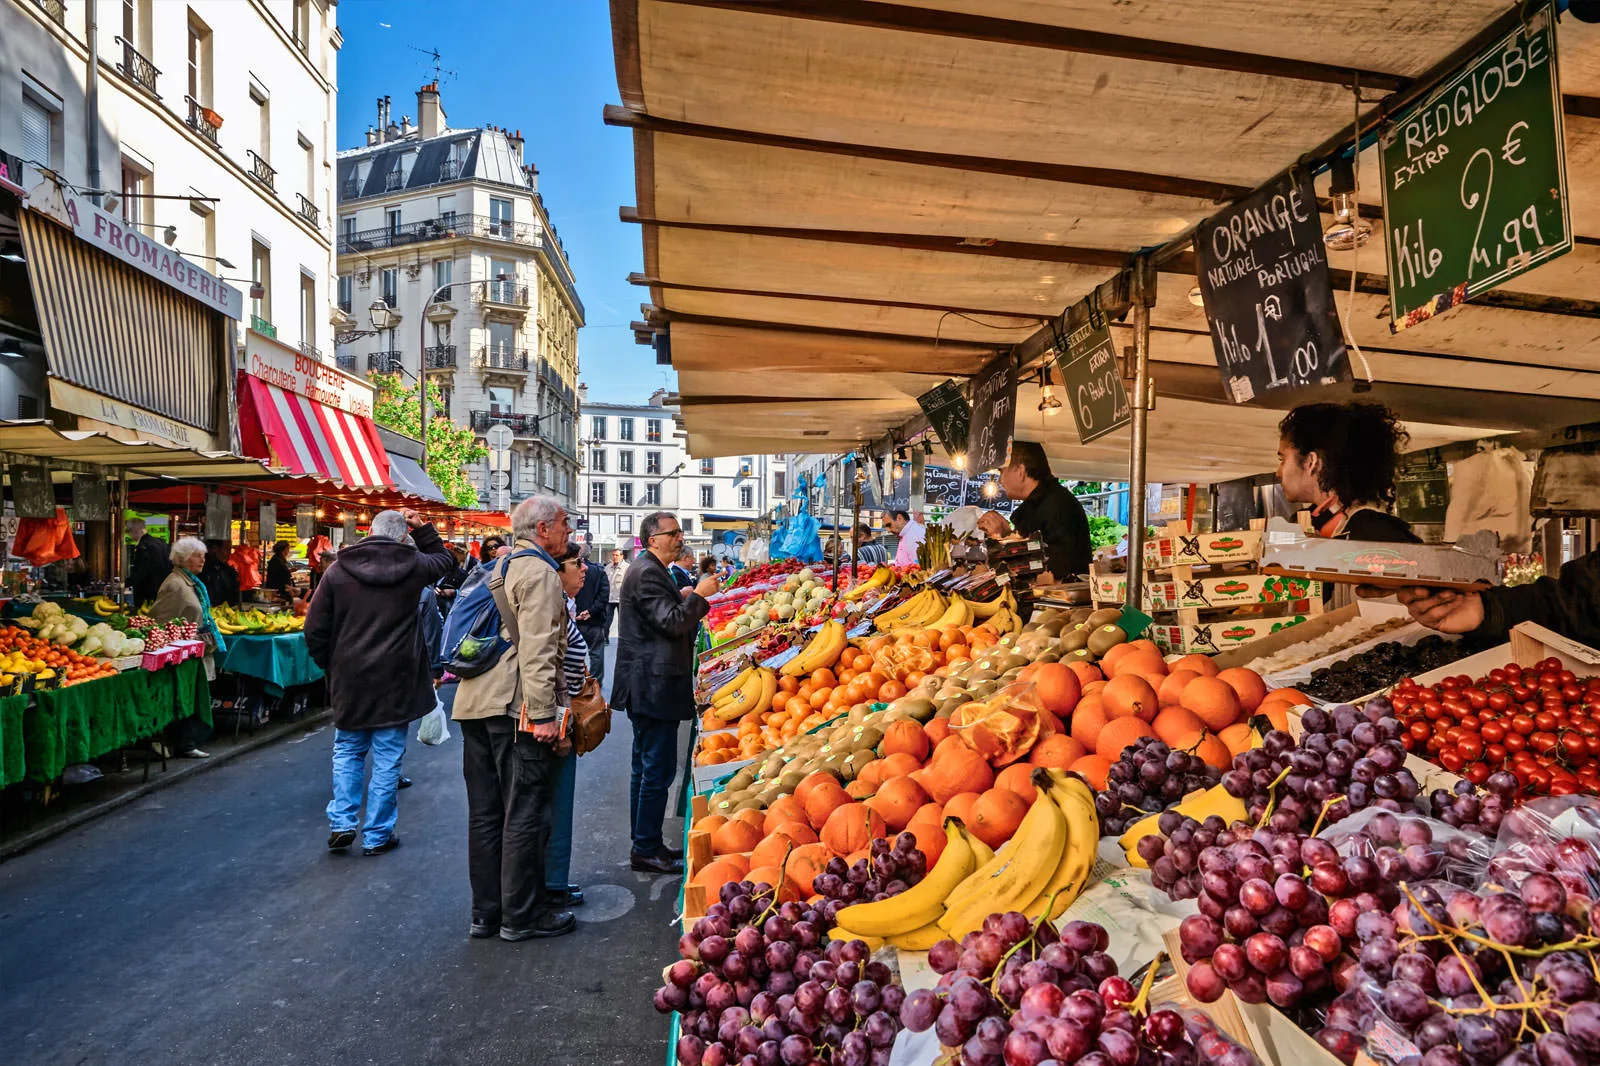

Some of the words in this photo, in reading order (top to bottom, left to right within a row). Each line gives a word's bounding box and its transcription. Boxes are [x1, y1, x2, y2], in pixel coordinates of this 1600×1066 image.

[1502, 121, 1529, 165] €
[1394, 144, 1449, 190] EXTRA
[1212, 188, 1309, 262] ORANGE
[93, 212, 229, 307] FROMAGERIE
[1208, 249, 1264, 290] NATUREL
[1257, 244, 1325, 289] PORTUGAL
[1394, 219, 1443, 288] Kilo
[1089, 348, 1110, 374] EXTRA
[1216, 319, 1252, 367] Kilo
[252, 353, 297, 392] Charcuterie
[295, 353, 345, 390] BOUCHERIE
[100, 399, 119, 421] LA
[131, 409, 191, 443] FROMAGERIE
[1078, 384, 1093, 430] 6
